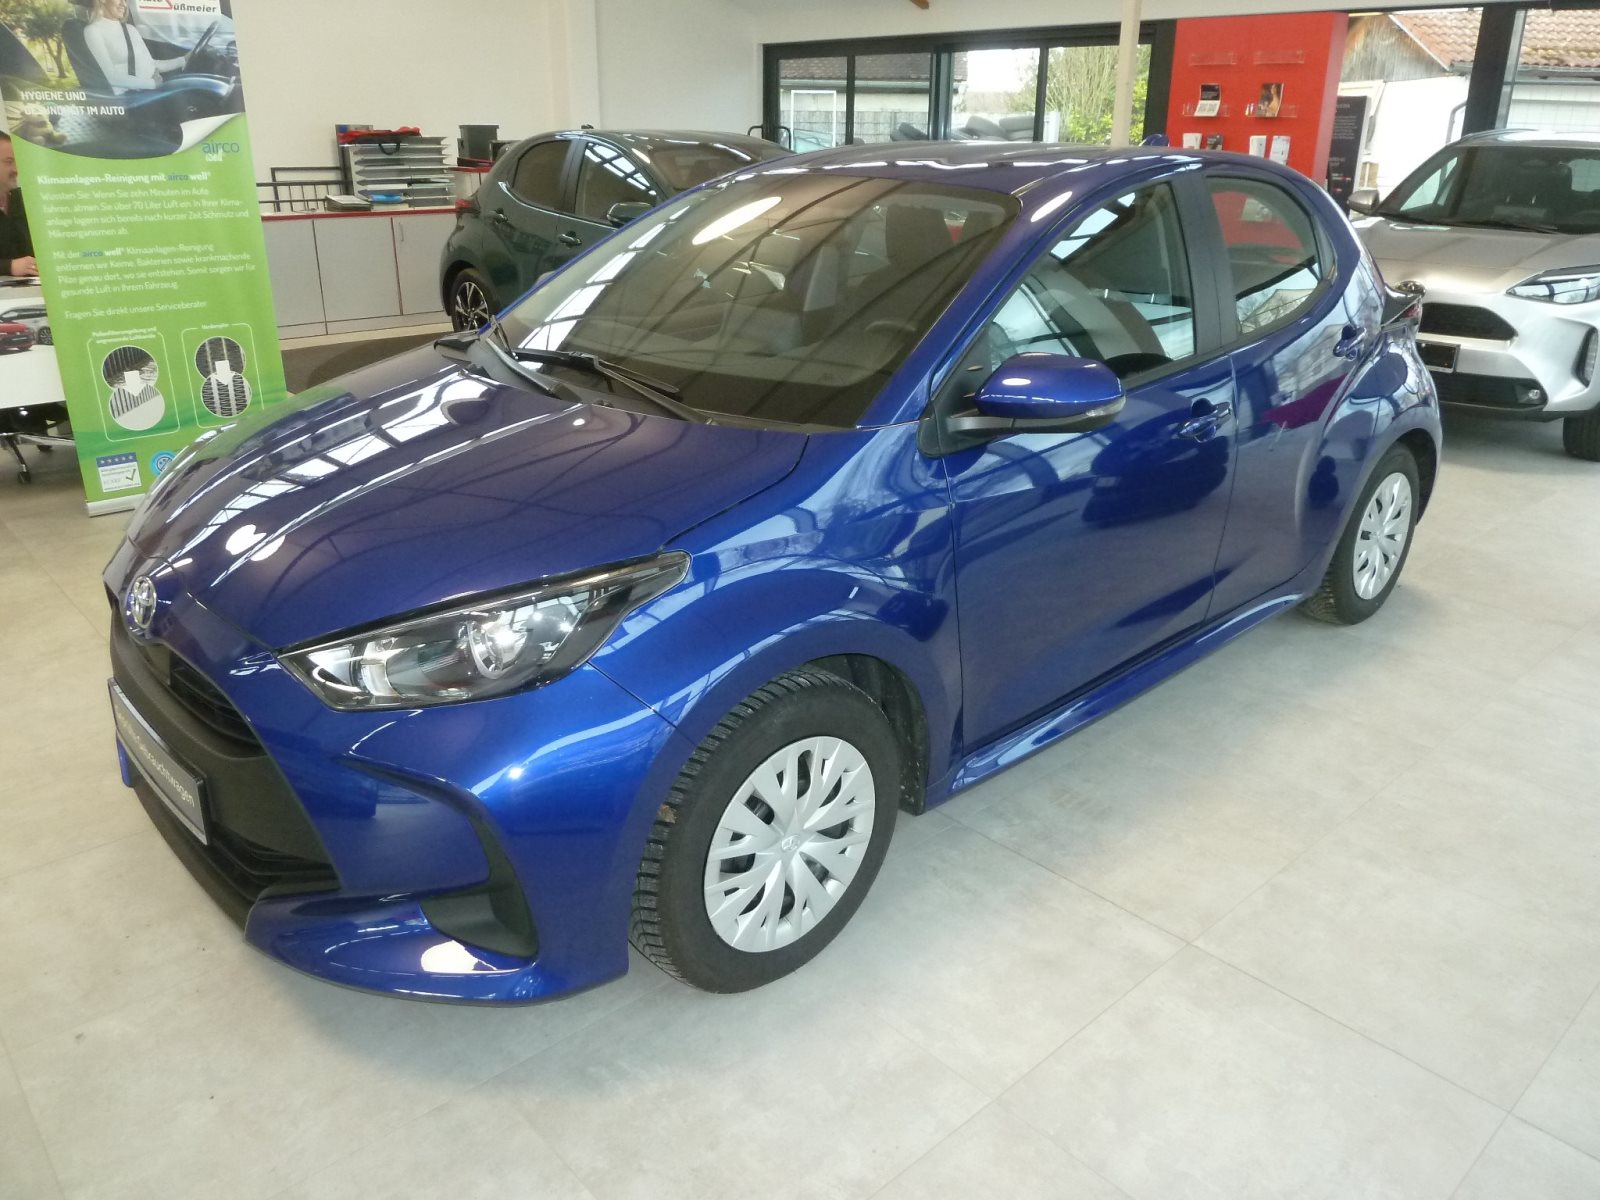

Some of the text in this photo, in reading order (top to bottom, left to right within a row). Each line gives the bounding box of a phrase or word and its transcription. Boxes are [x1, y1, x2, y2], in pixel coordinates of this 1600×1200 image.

[21, 90, 87, 100] HYGIENE UND
[87, 106, 98, 115] IM
[100, 106, 125, 115] AUTO
[202, 142, 240, 154] airco
[37, 174, 149, 185] Klimaanlagen-Reinigung
[151, 173, 166, 181] mit
[116, 189, 129, 198] Sie
[100, 201, 112, 211] Sie
[132, 200, 144, 209] 70
[163, 200, 179, 208] Luft
[235, 209, 249, 218] und
[95, 284, 112, 294] Luft
